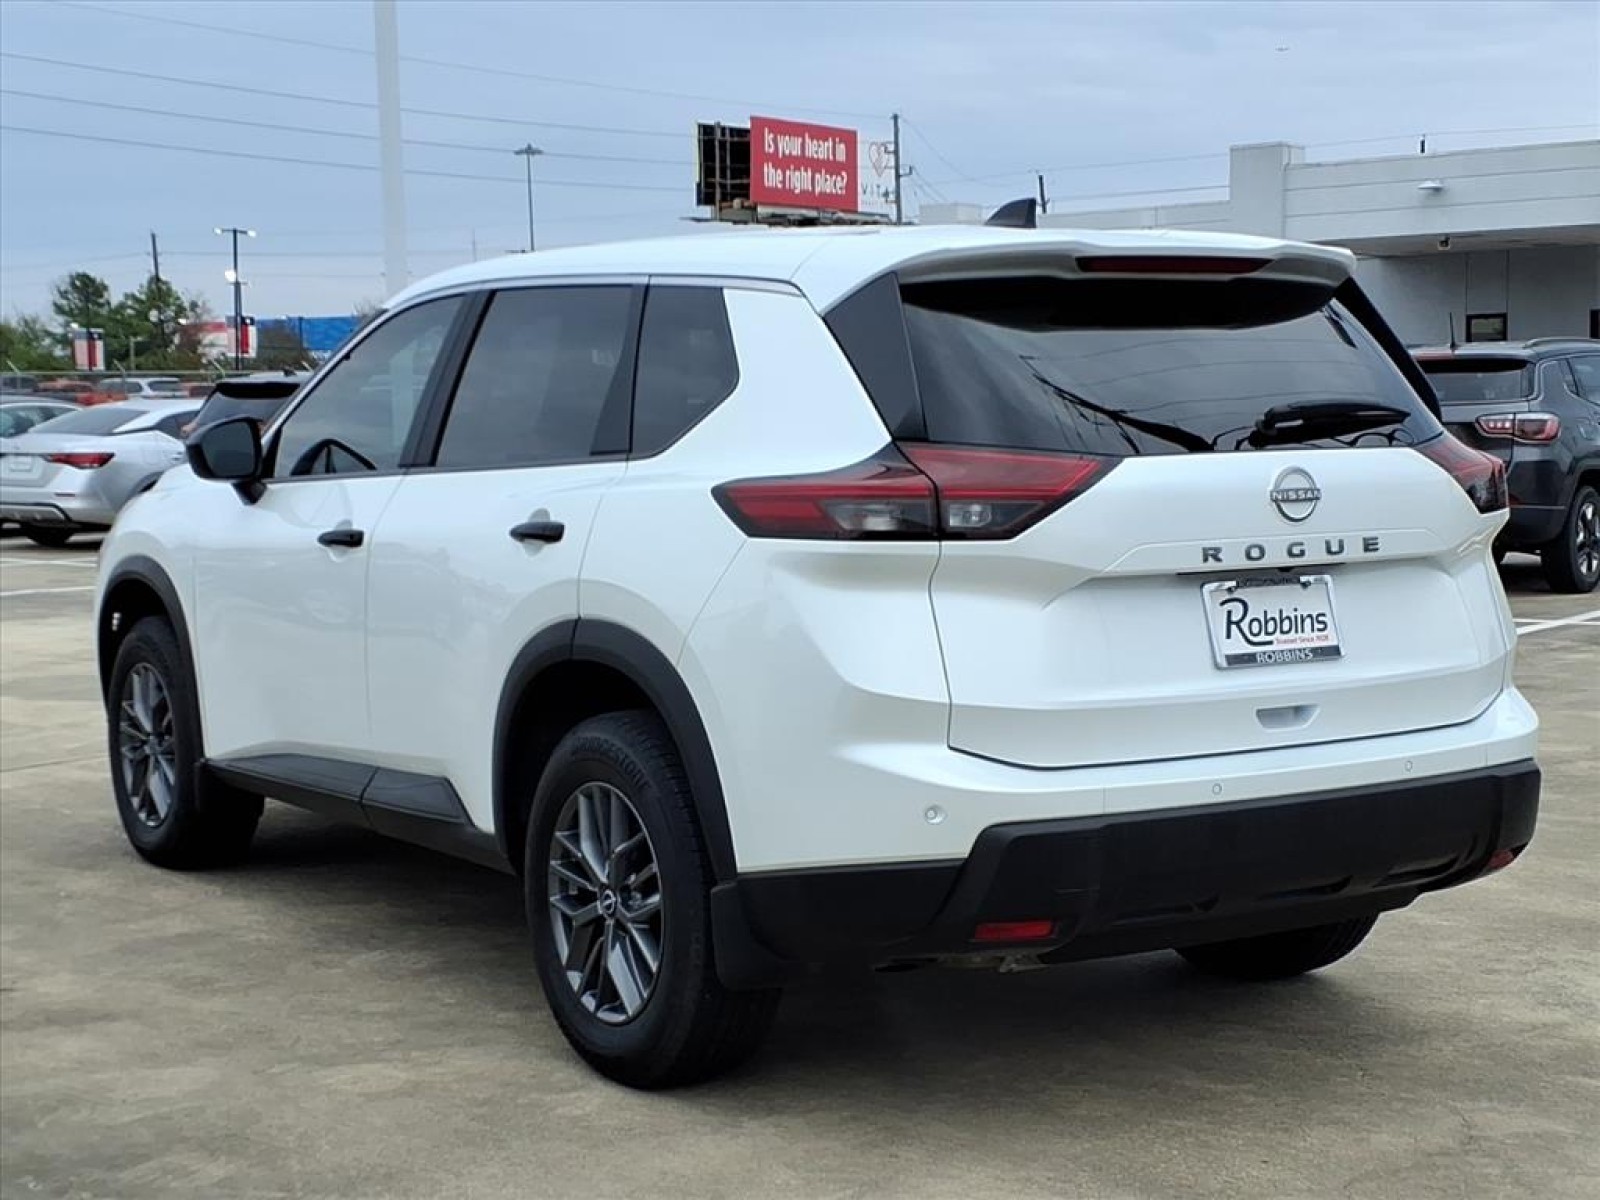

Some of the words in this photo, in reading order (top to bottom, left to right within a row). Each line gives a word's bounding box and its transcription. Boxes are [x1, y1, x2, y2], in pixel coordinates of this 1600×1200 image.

[764, 127, 774, 153] Is
[777, 134, 801, 158] your
[805, 133, 833, 161] heart
[835, 138, 846, 163] in
[763, 162, 782, 188] the
[785, 165, 812, 195] right
[815, 168, 848, 197] place?
[1272, 489, 1320, 501] NISSAN
[1202, 536, 1380, 563] ROGUE
[1219, 597, 1328, 646] Robbins
[1256, 648, 1314, 664] ROBBINS
